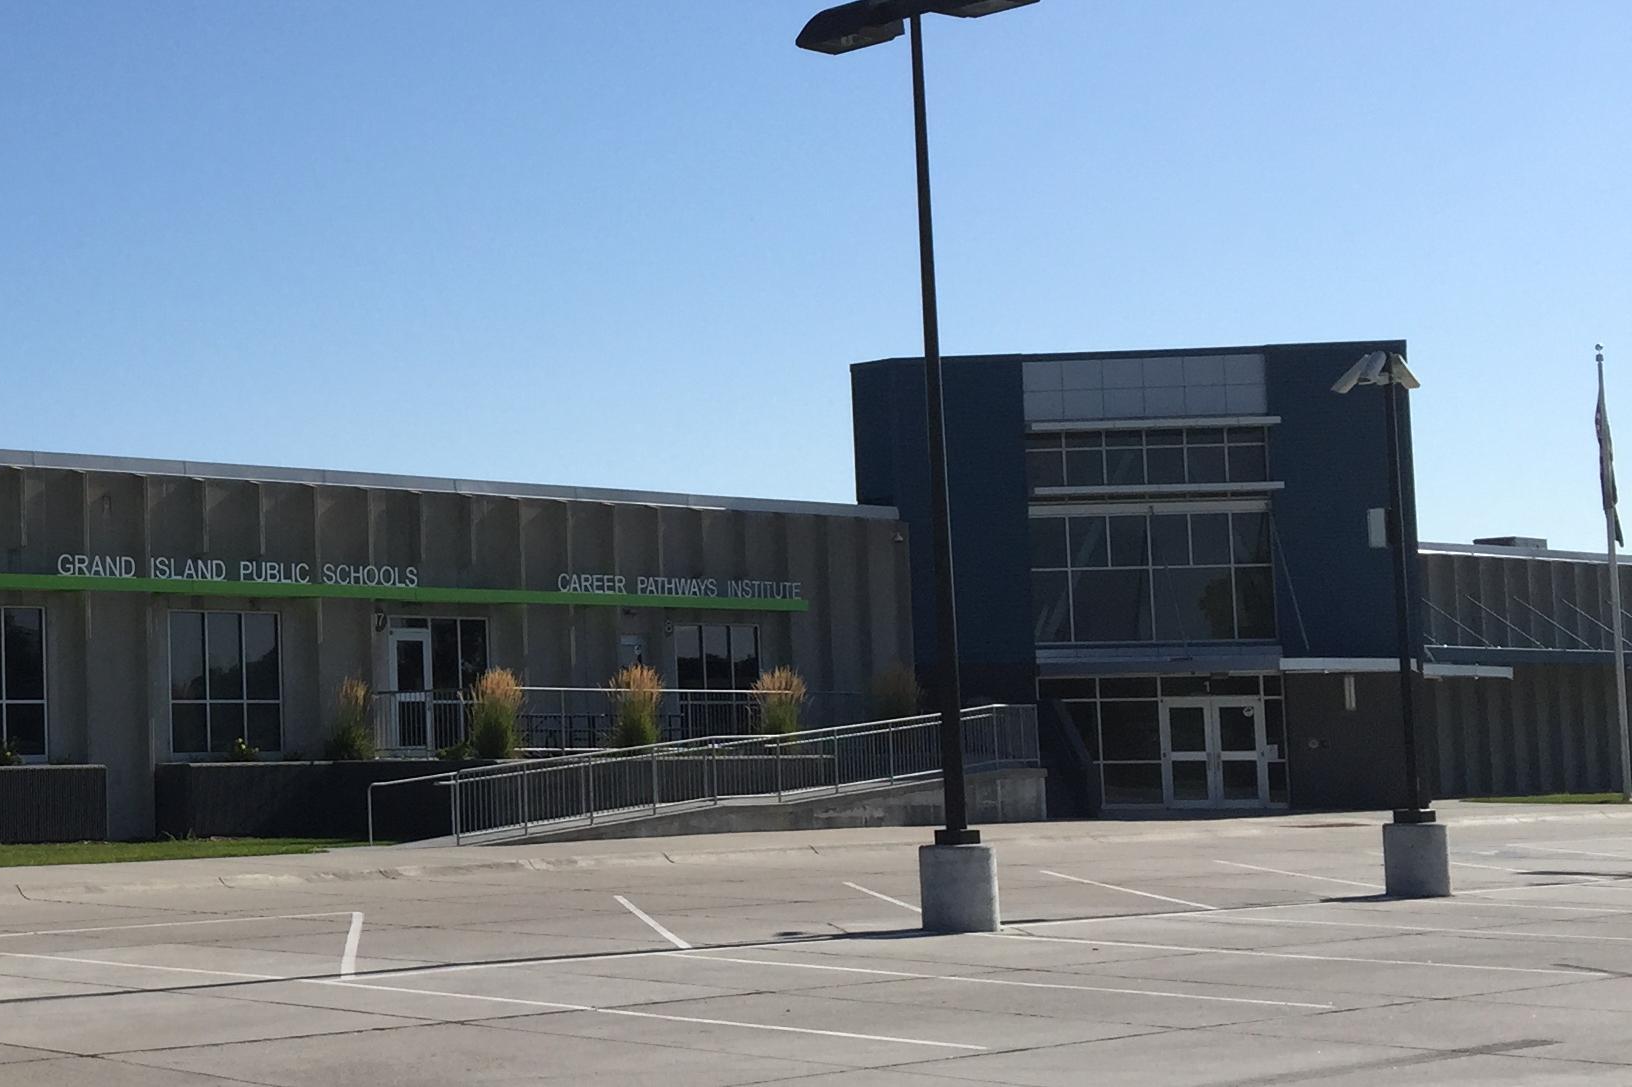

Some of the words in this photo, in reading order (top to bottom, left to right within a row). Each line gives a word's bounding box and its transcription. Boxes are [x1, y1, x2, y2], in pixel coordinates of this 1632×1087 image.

[57, 553, 136, 578] GRAND
[150, 557, 226, 581] ISLAND
[240, 561, 310, 584] PUBLIC
[323, 563, 418, 587] SCHOOLS
[558, 573, 627, 594] CAREER
[637, 577, 717, 597] PATHWAYS
[727, 580, 801, 600] INSTITUTE
